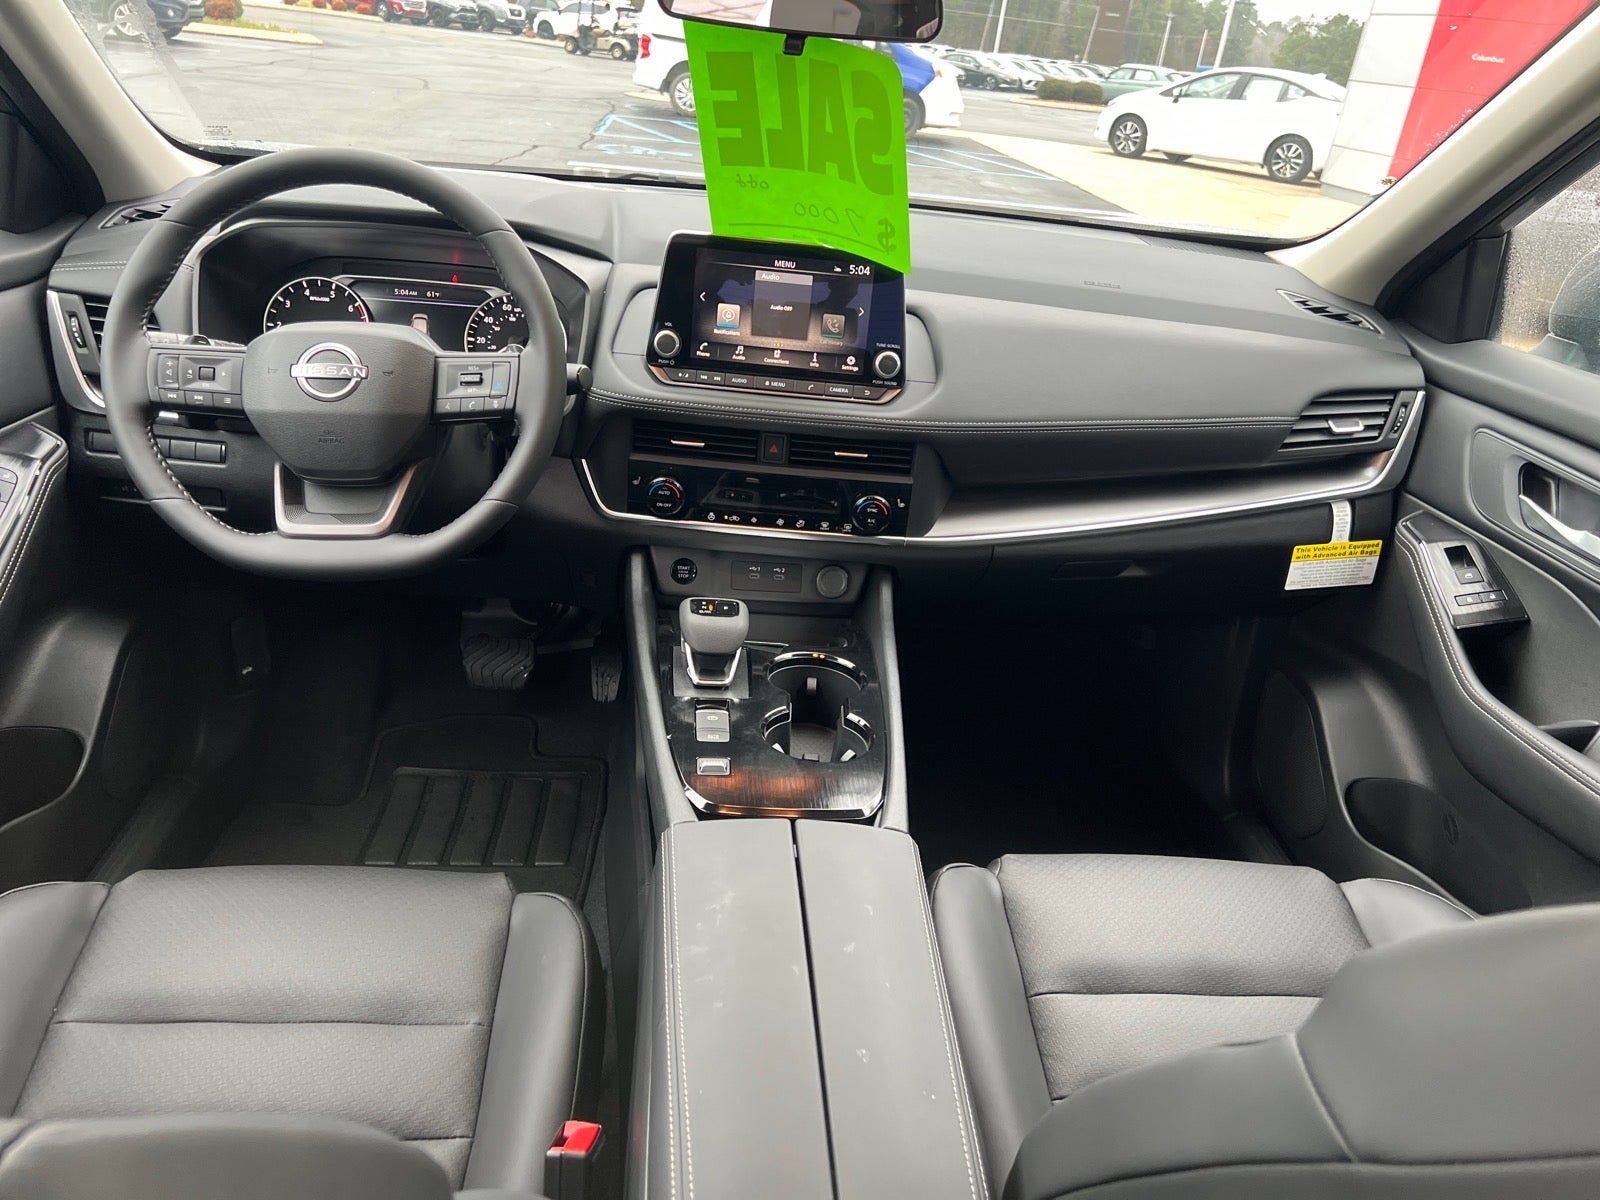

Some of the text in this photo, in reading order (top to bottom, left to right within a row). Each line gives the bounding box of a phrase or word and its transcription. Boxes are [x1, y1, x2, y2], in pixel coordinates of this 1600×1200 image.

[774, 259, 796, 269] MENU
[849, 264, 871, 276] 5:04
[761, 273, 780, 281] Audio
[304, 288, 310, 297] 4
[329, 290, 336, 299] 5
[284, 300, 291, 308] 3
[347, 304, 354, 312] 6
[502, 303, 512, 311] 60
[483, 316, 494, 324] 40
[713, 328, 741, 336] Notifications
[476, 336, 486, 344] 20
[696, 350, 711, 358] Phone
[763, 356, 790, 365] Connections
[292, 366, 366, 378] ISSAN
[841, 364, 859, 372] Settings
[829, 386, 849, 394] CAMERA
[1312, 551, 1346, 559] Advanced
